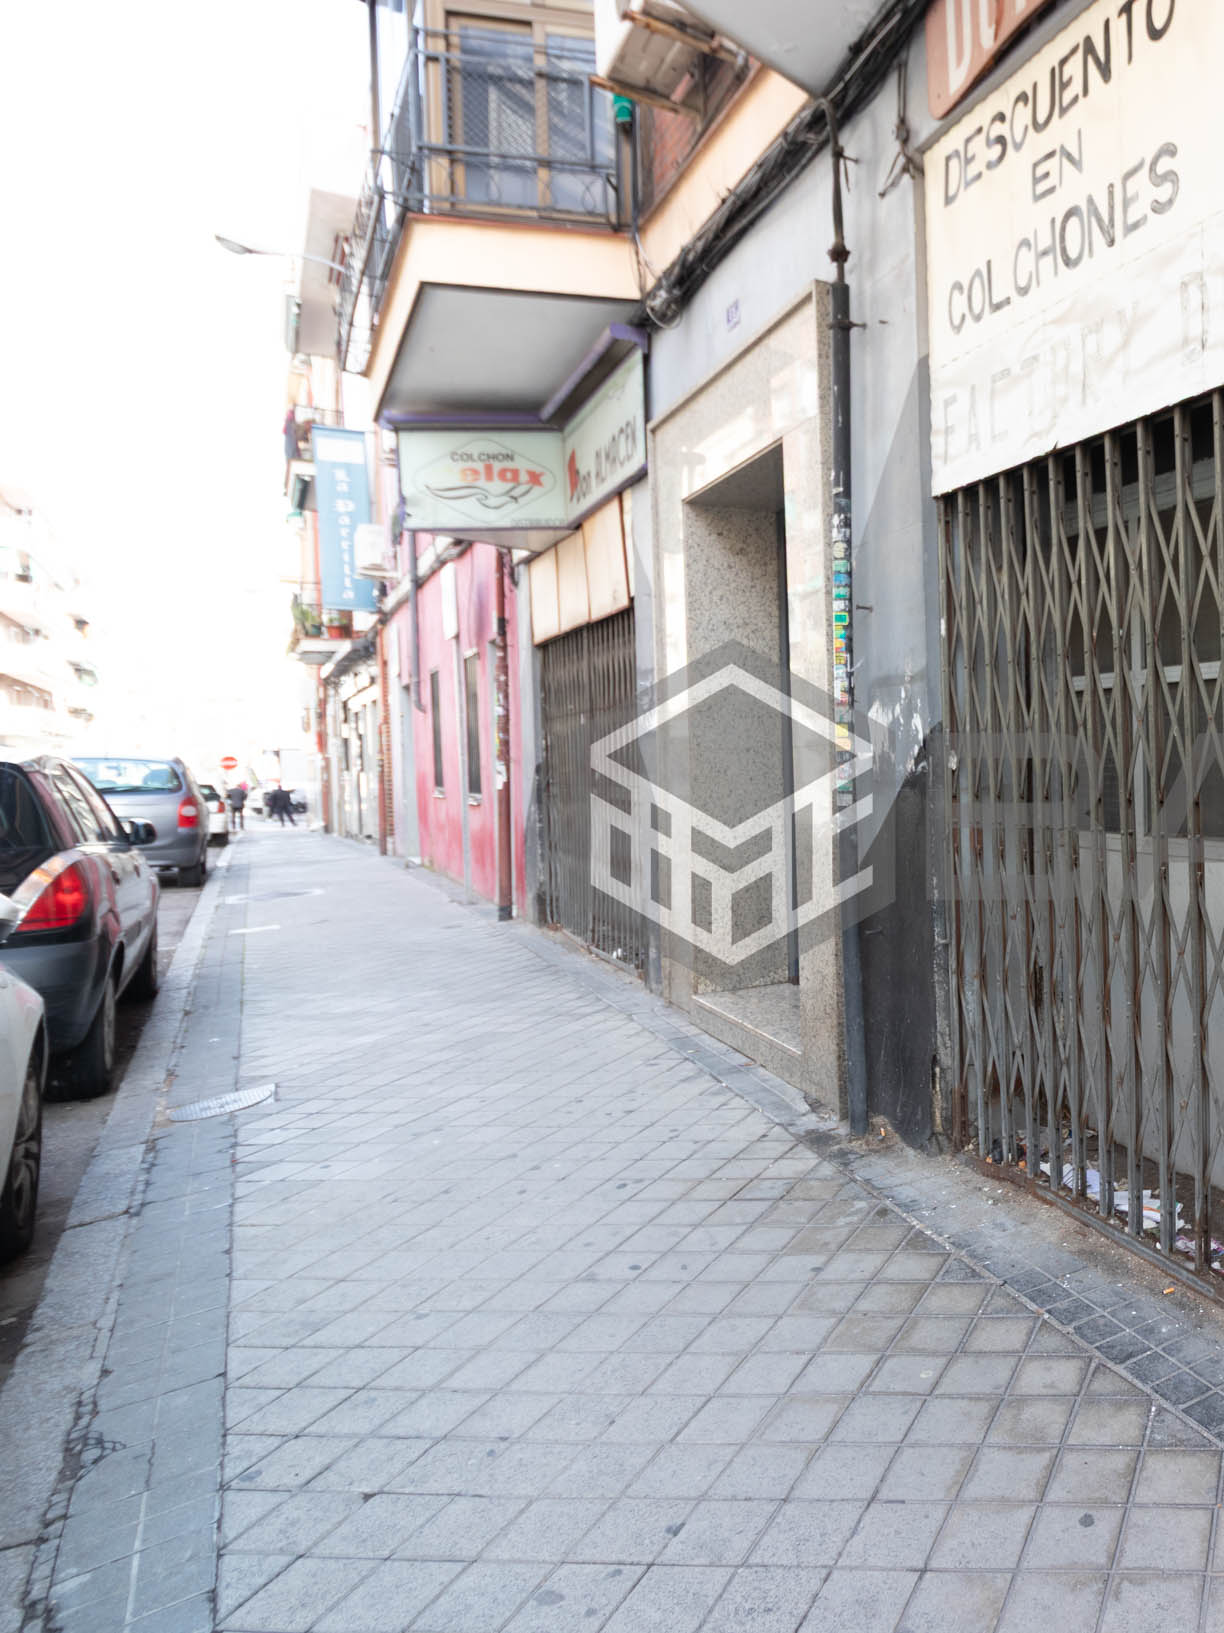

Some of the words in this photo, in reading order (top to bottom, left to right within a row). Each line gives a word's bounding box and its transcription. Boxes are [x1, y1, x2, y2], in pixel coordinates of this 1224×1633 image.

[944, 0, 1176, 207] DESCUENTO
[1032, 128, 1083, 204] EN
[949, 142, 1180, 335] COLCHONES
[451, 451, 514, 463] COLCHON
[456, 463, 545, 487] elax
